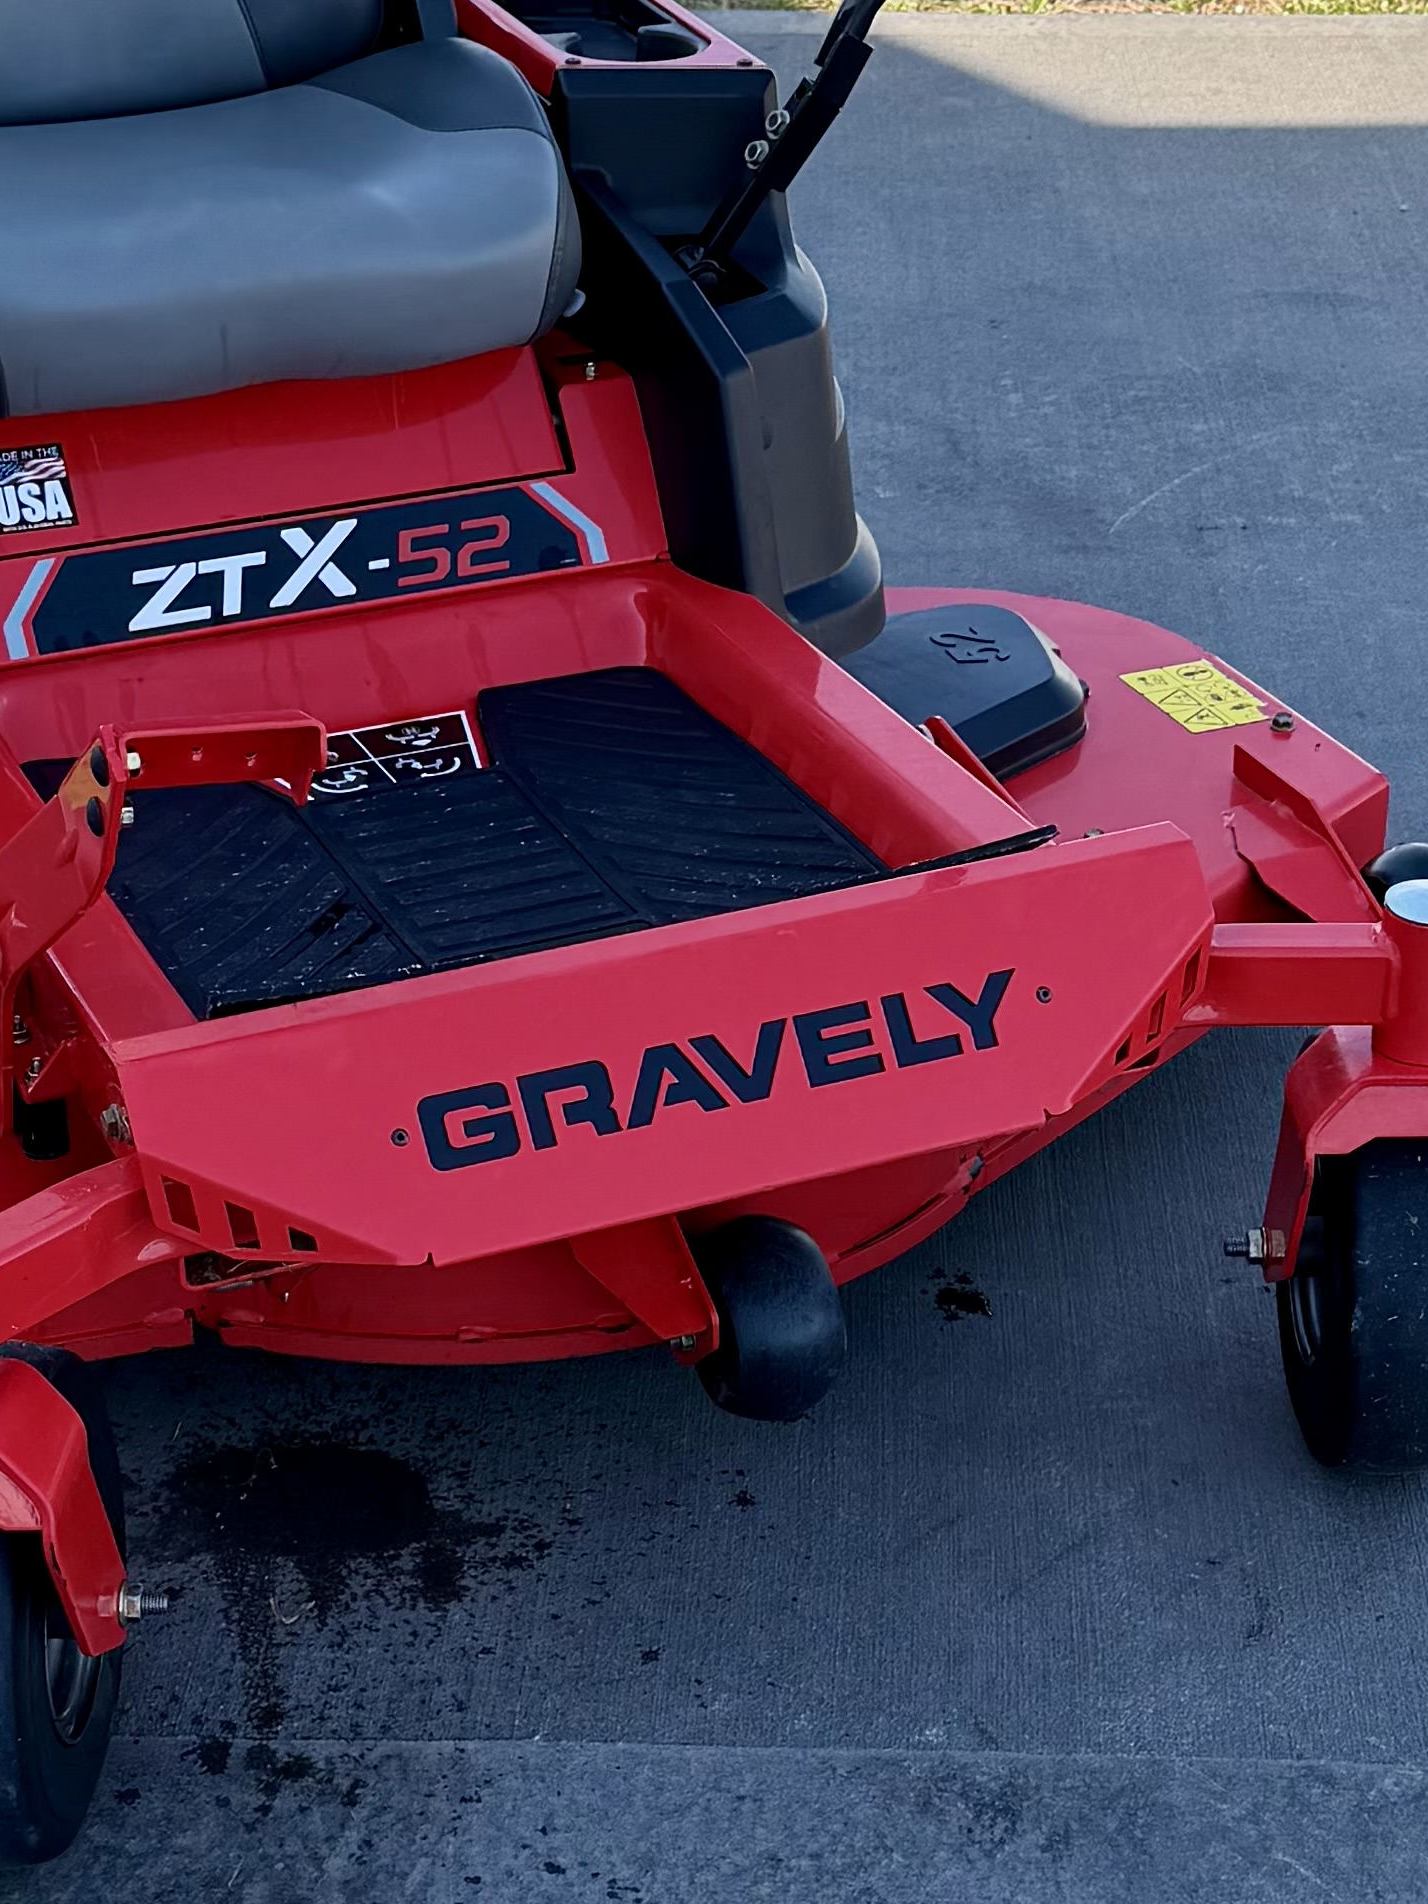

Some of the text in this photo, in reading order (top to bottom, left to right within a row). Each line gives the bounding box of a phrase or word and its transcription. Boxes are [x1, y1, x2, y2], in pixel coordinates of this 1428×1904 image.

[20, 449, 34, 460] IN
[35, 445, 60, 458] THE
[416, 967, 1016, 1173] GRAVELY
